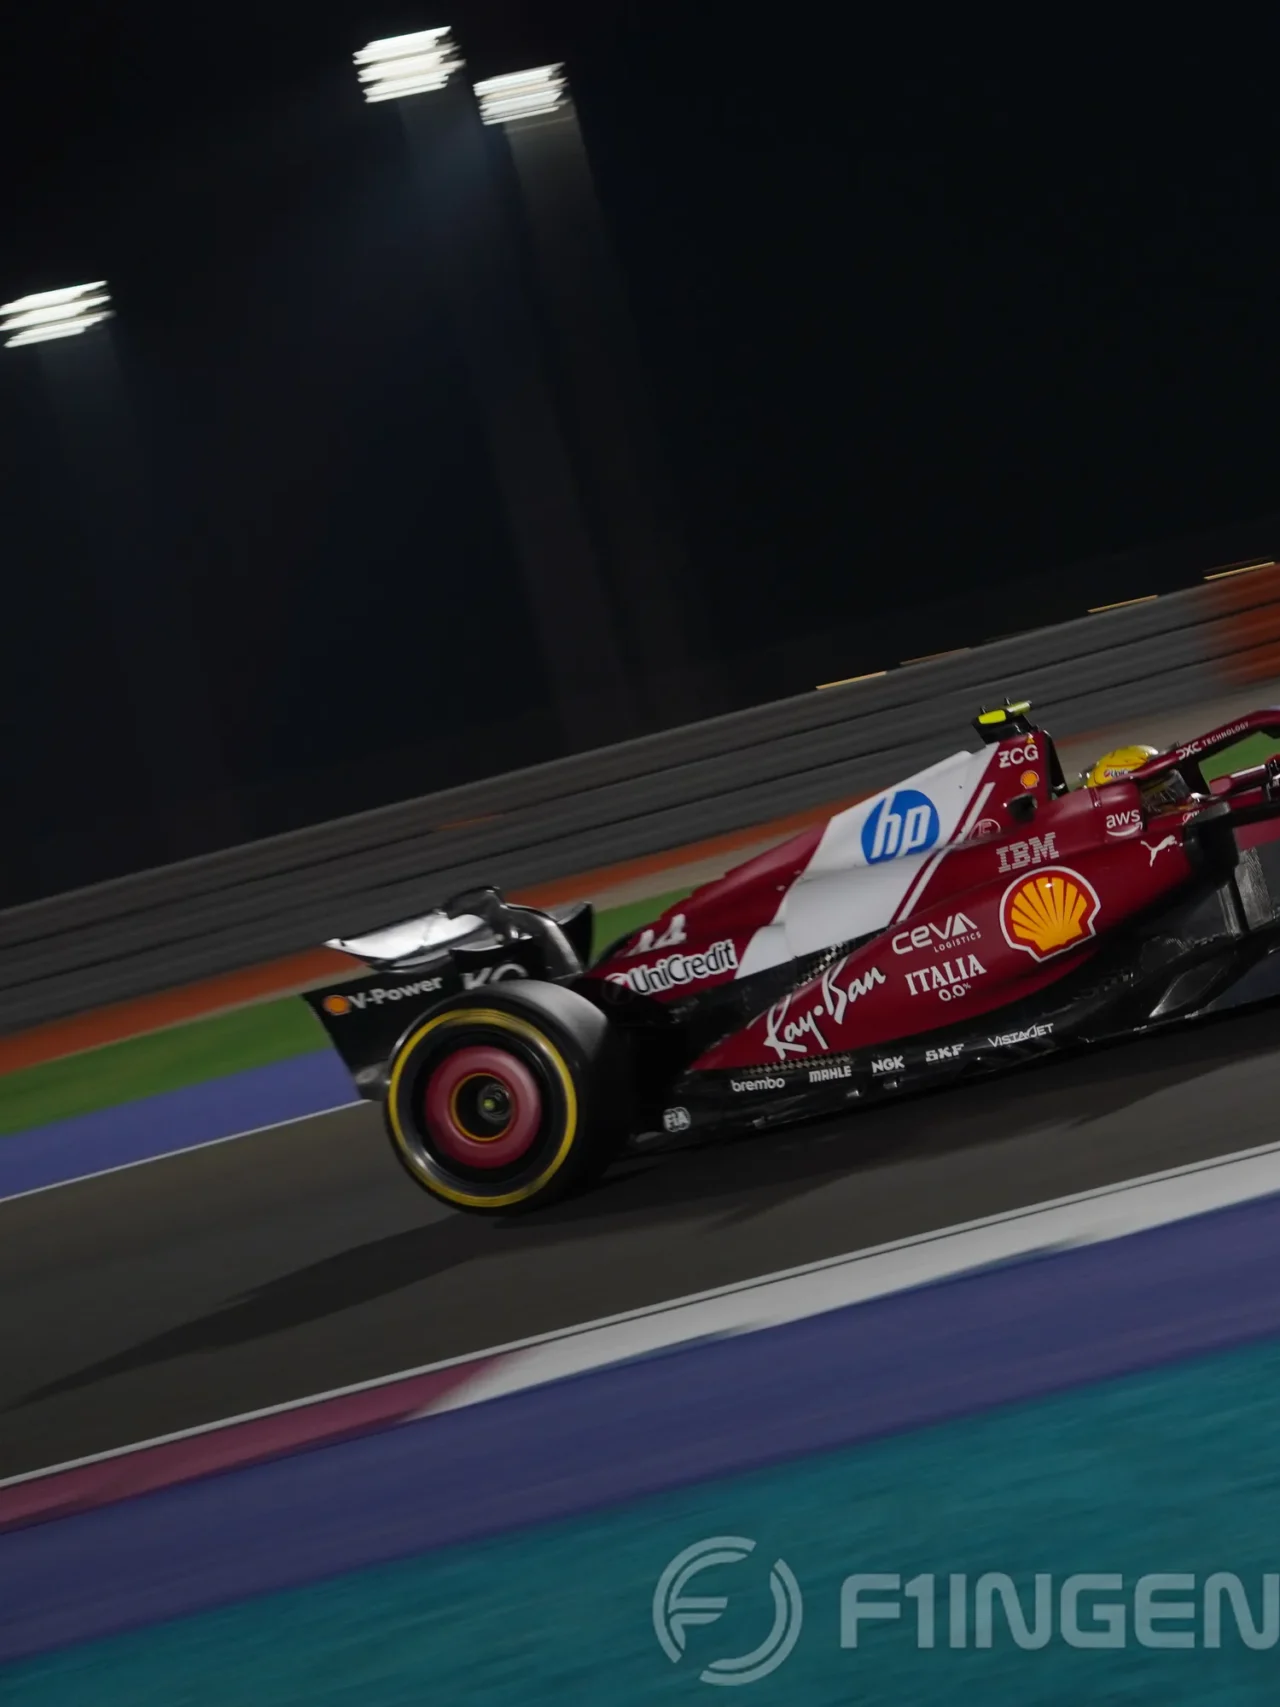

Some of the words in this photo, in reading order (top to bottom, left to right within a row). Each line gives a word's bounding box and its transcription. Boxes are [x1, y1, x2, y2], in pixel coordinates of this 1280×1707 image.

[1201, 721, 1250, 747] TECHNOLOGY
[868, 790, 932, 858] hp
[1105, 809, 1141, 829] aws
[996, 831, 1060, 873] IBM
[934, 930, 983, 953] LOGISTICS
[627, 938, 741, 996] UniCredit
[904, 954, 988, 996] ITALIA
[349, 976, 444, 1010] V-Power
[938, 982, 972, 1002] 0.0%
[871, 1055, 906, 1074] NGK
[925, 1043, 965, 1063] SKF
[730, 1076, 786, 1092] brembo
[809, 1065, 852, 1083] MAHLE
[663, 1108, 691, 1131] FIA
